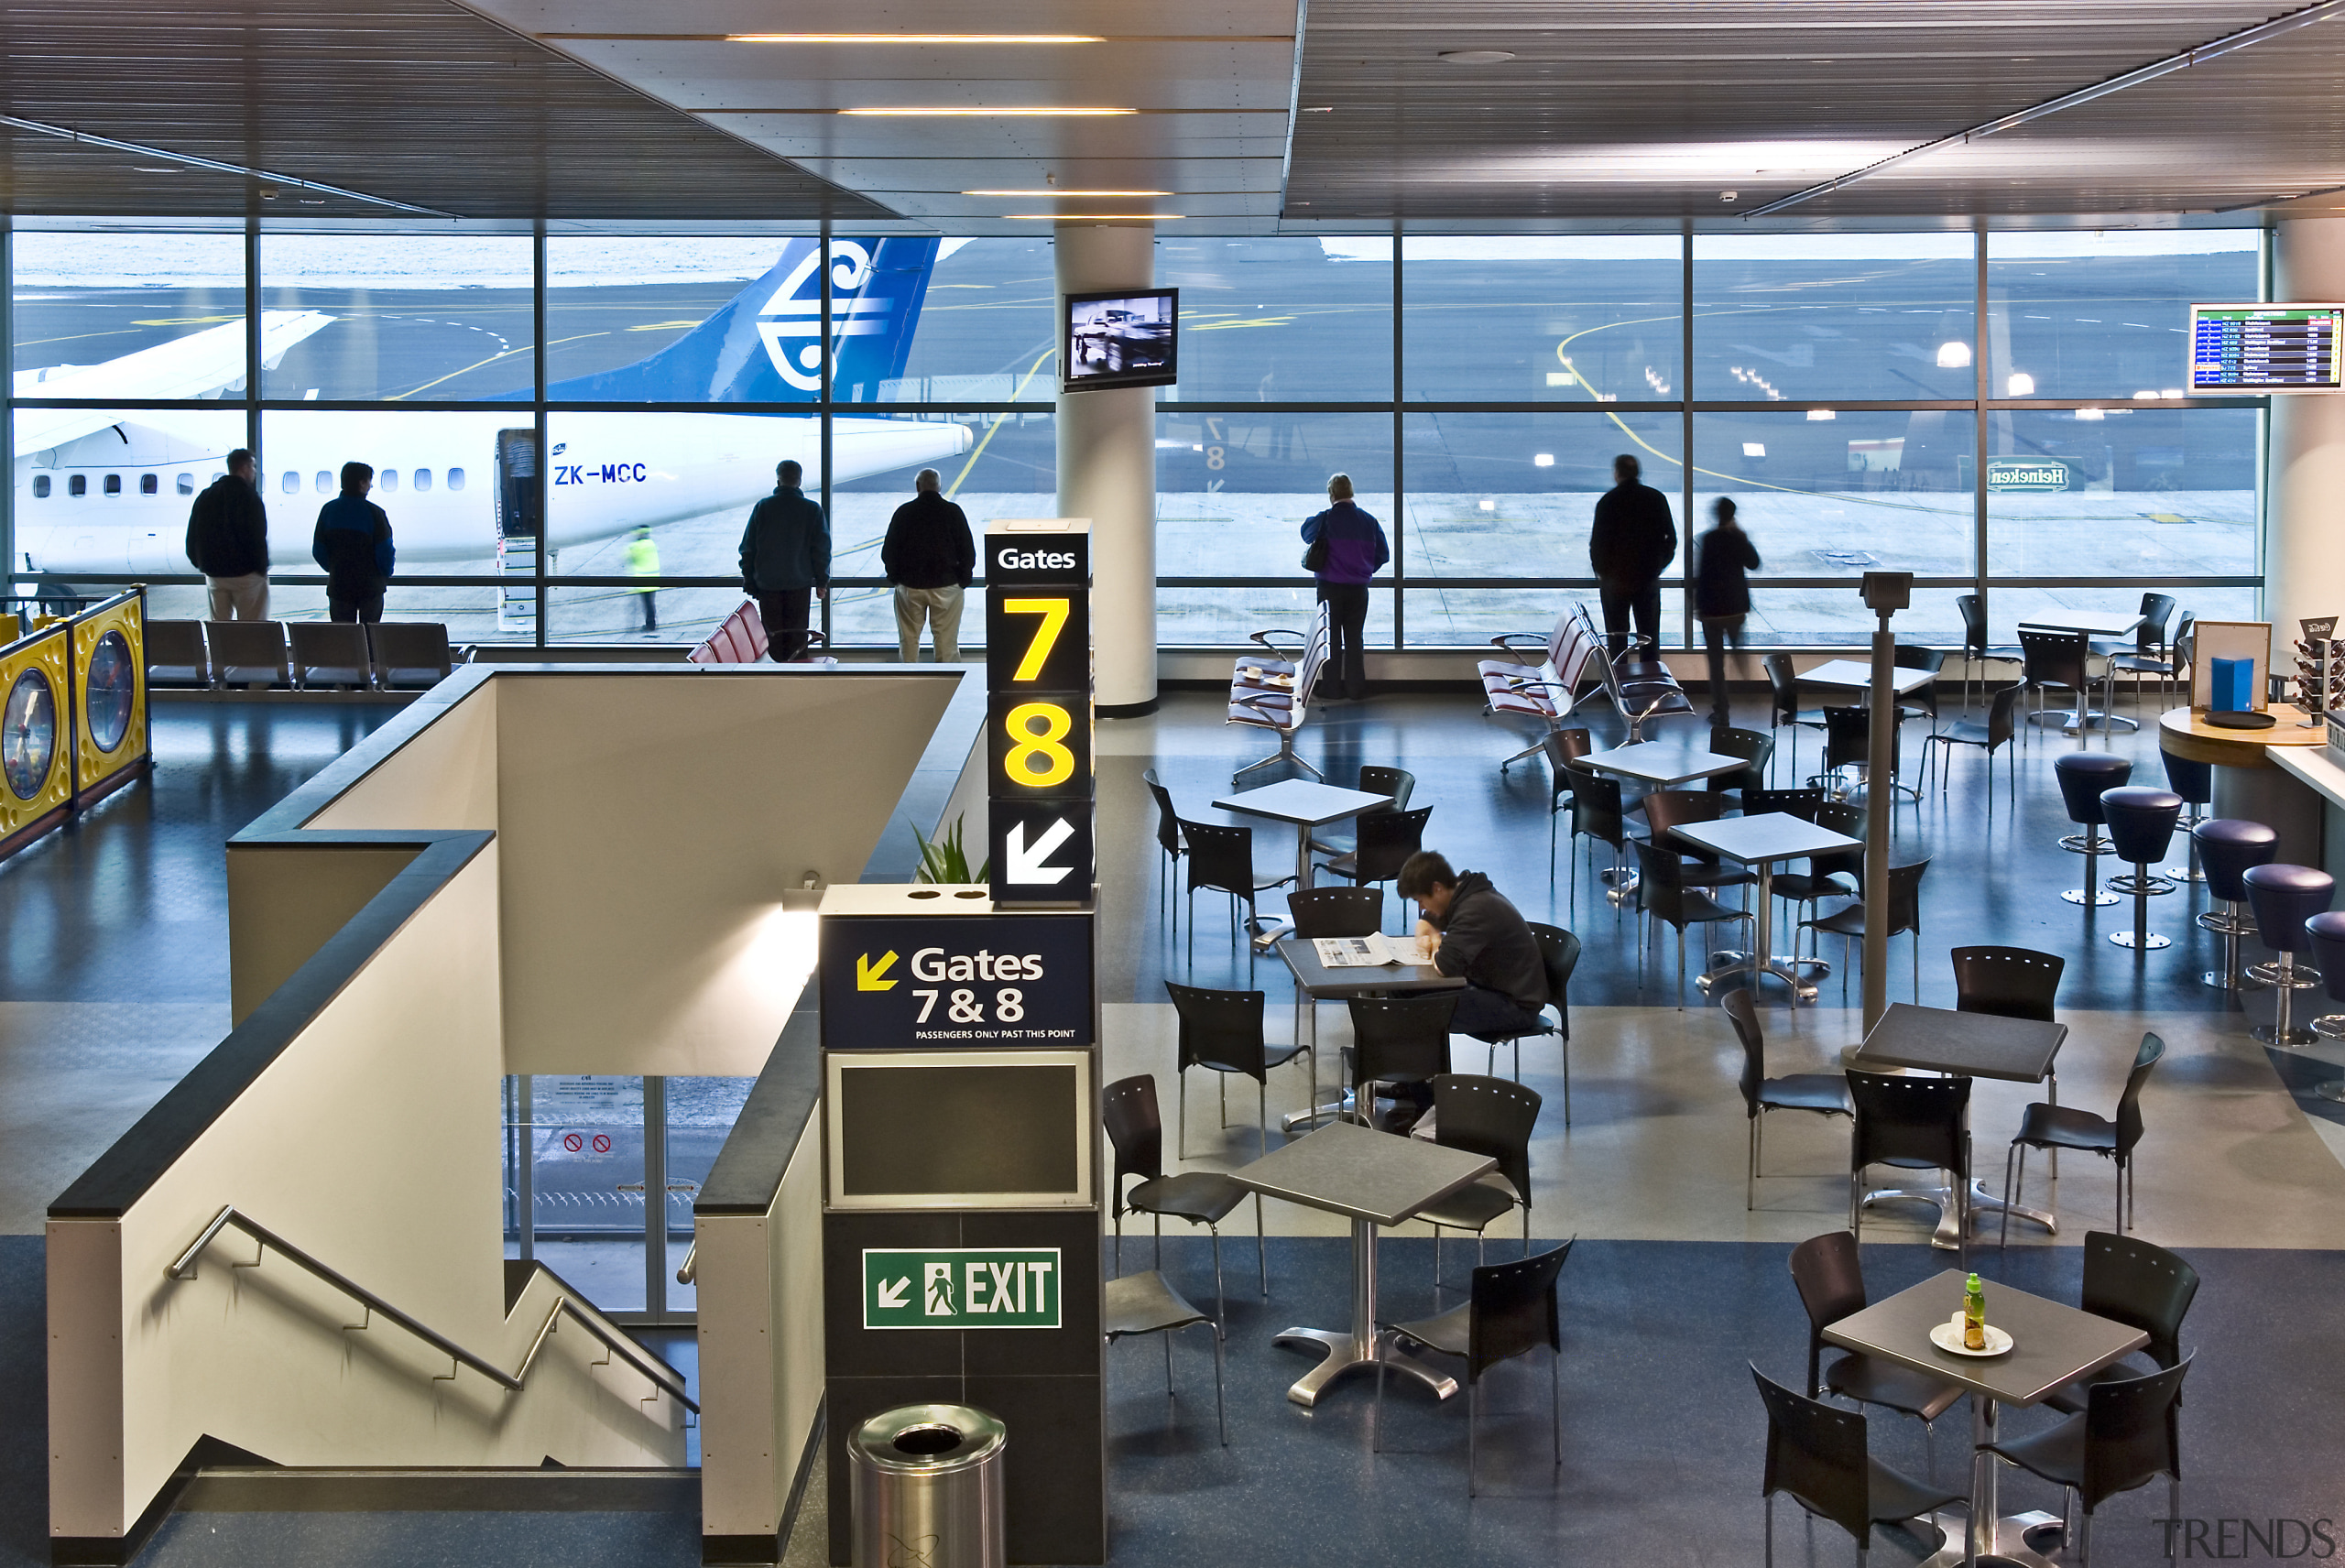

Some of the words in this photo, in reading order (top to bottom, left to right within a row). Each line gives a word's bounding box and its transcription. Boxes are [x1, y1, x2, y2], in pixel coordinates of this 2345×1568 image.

[554, 463, 647, 485] ZK-MCC
[998, 548, 1075, 570] Gates
[1004, 597, 1070, 681] 7
[1004, 702, 1074, 788] 8
[911, 947, 1044, 982] Gates
[912, 989, 939, 1024] 7
[948, 988, 986, 1023] &
[996, 987, 1024, 1023] 8
[916, 1030, 973, 1040] PASSENGERS
[975, 1030, 998, 1039] ONLY
[1001, 1030, 1023, 1039] PAST
[1025, 1029, 1045, 1039] THIS
[1048, 1029, 1075, 1039] POINT
[965, 1261, 1053, 1313] EXIT
